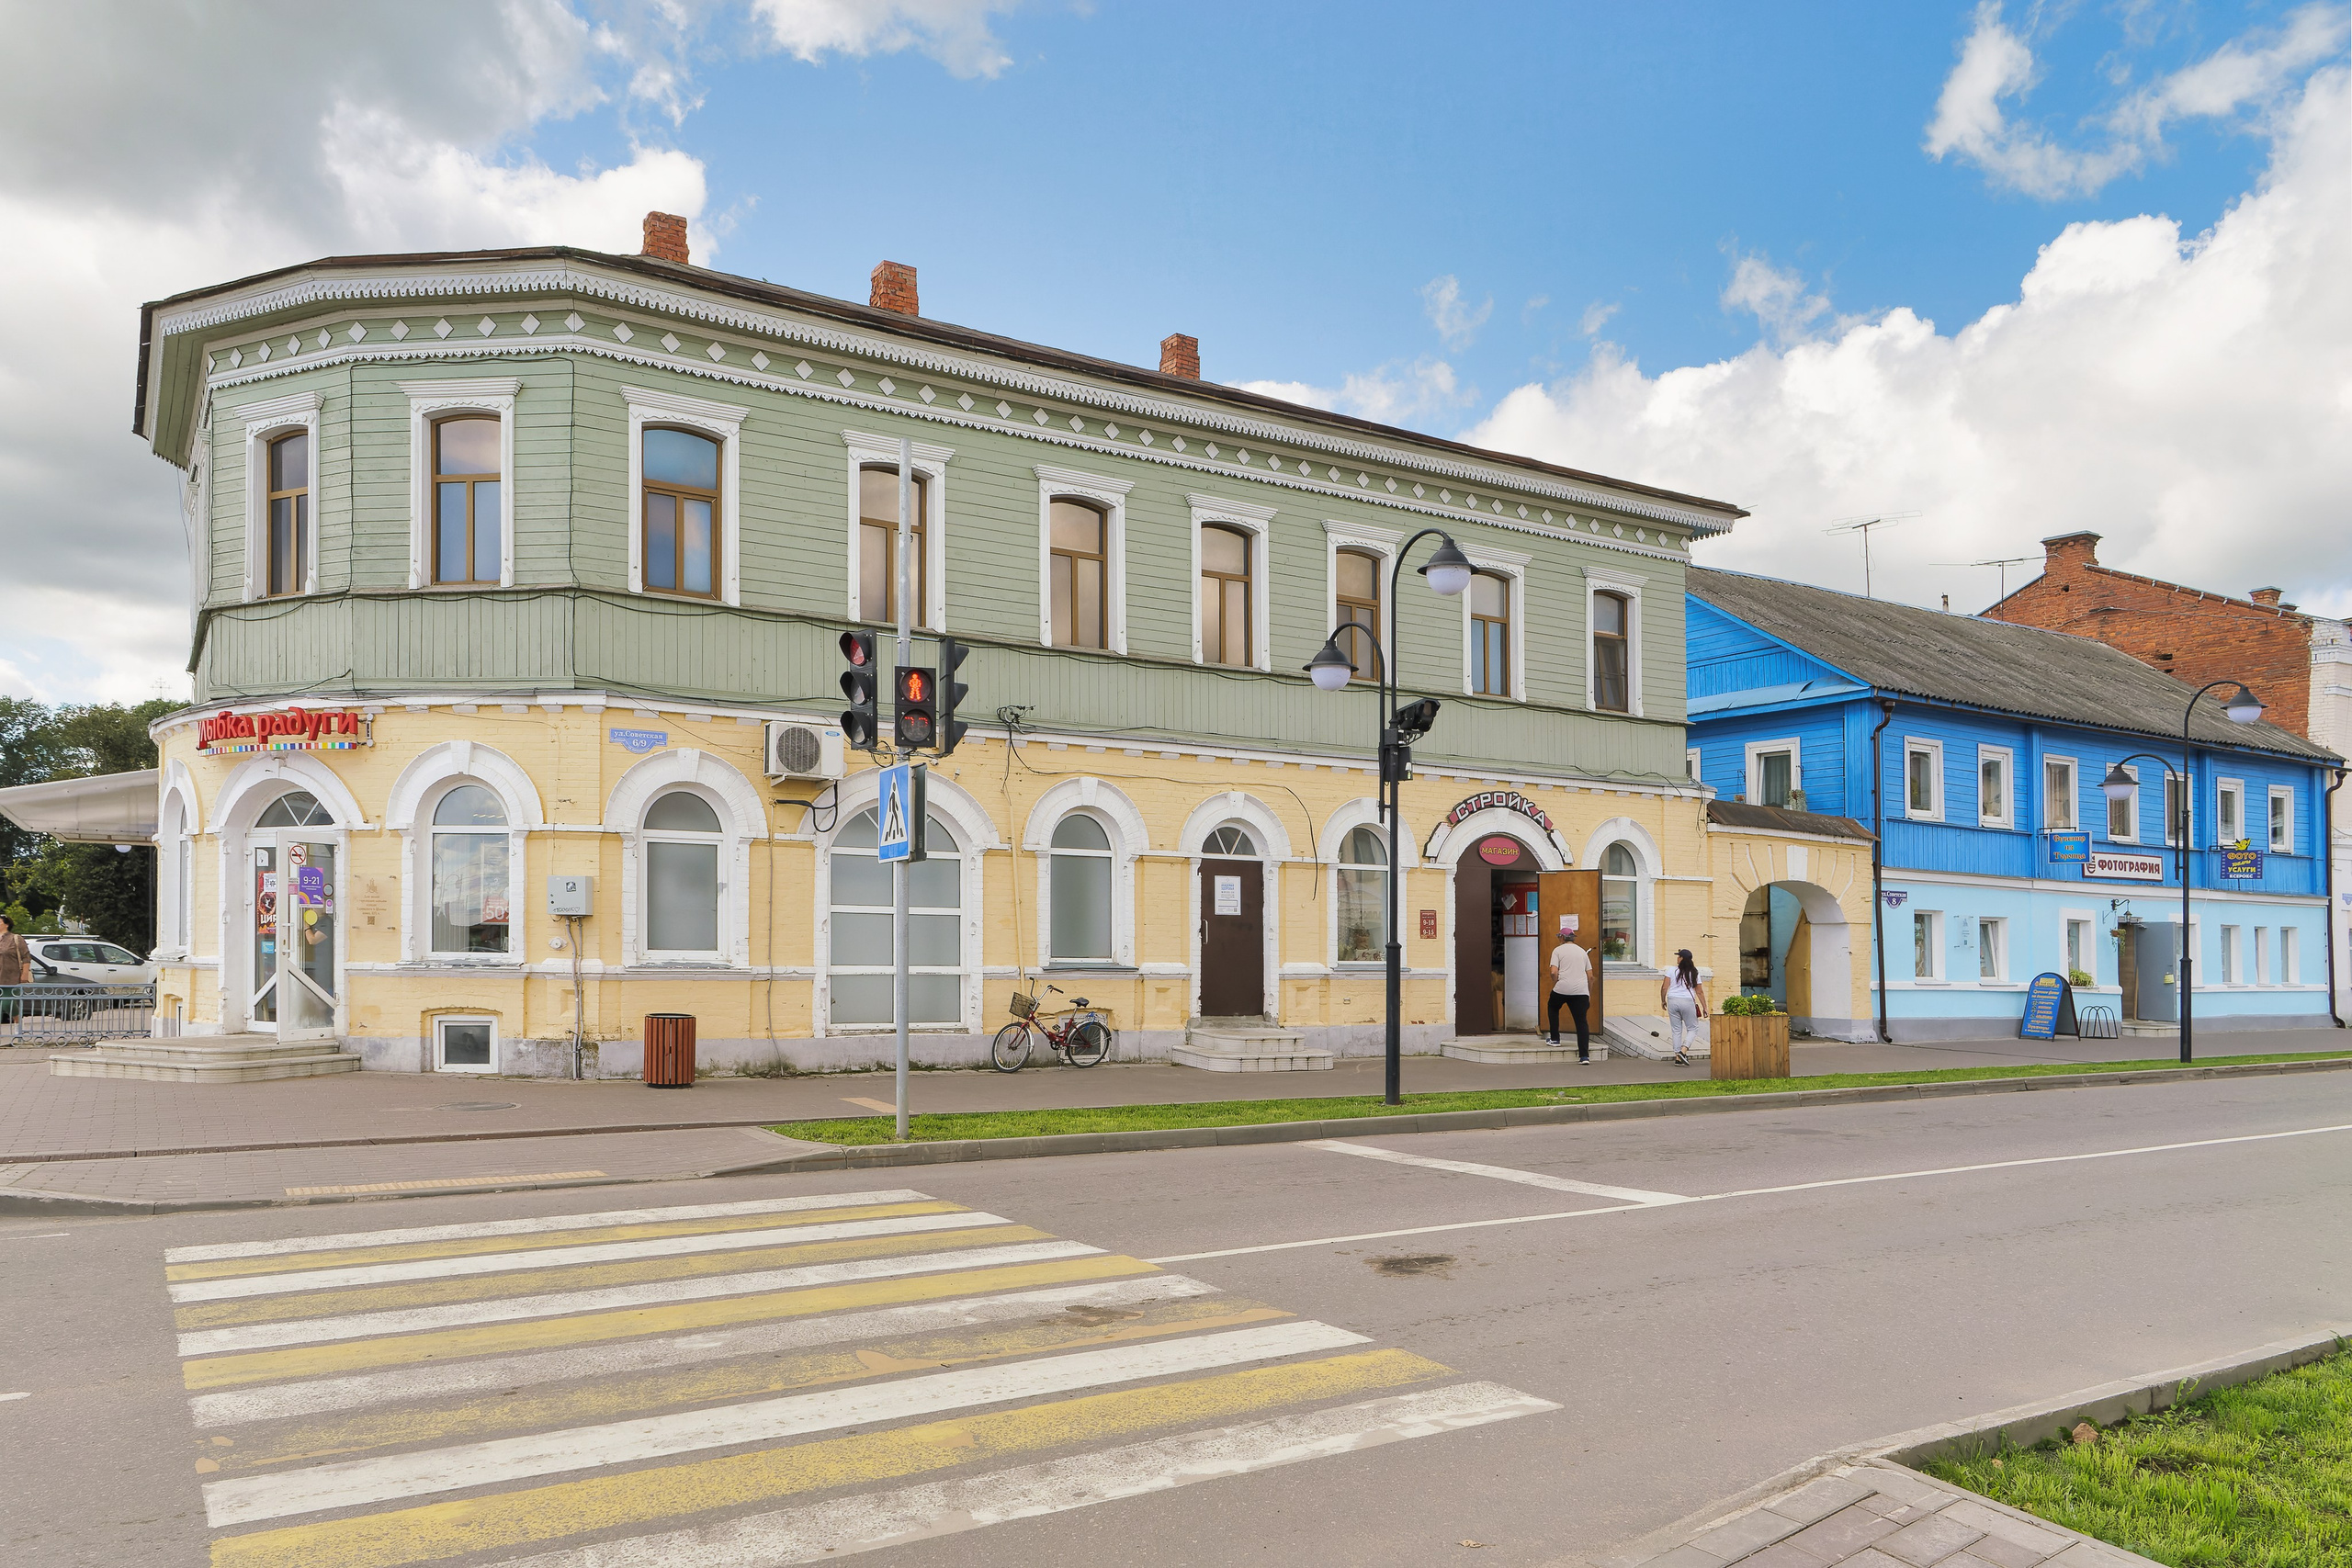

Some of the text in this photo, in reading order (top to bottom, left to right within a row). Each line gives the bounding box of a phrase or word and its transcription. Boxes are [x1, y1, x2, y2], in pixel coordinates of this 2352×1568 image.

[258, 706, 358, 744] радуги
[632, 739, 647, 748] 6/9
[1455, 791, 1547, 829] СТРОЙКА
[1481, 847, 1519, 855] МАГАЗИН
[2098, 859, 2160, 874] ФОТОГРАФИЯ
[303, 875, 320, 885] 9-21
